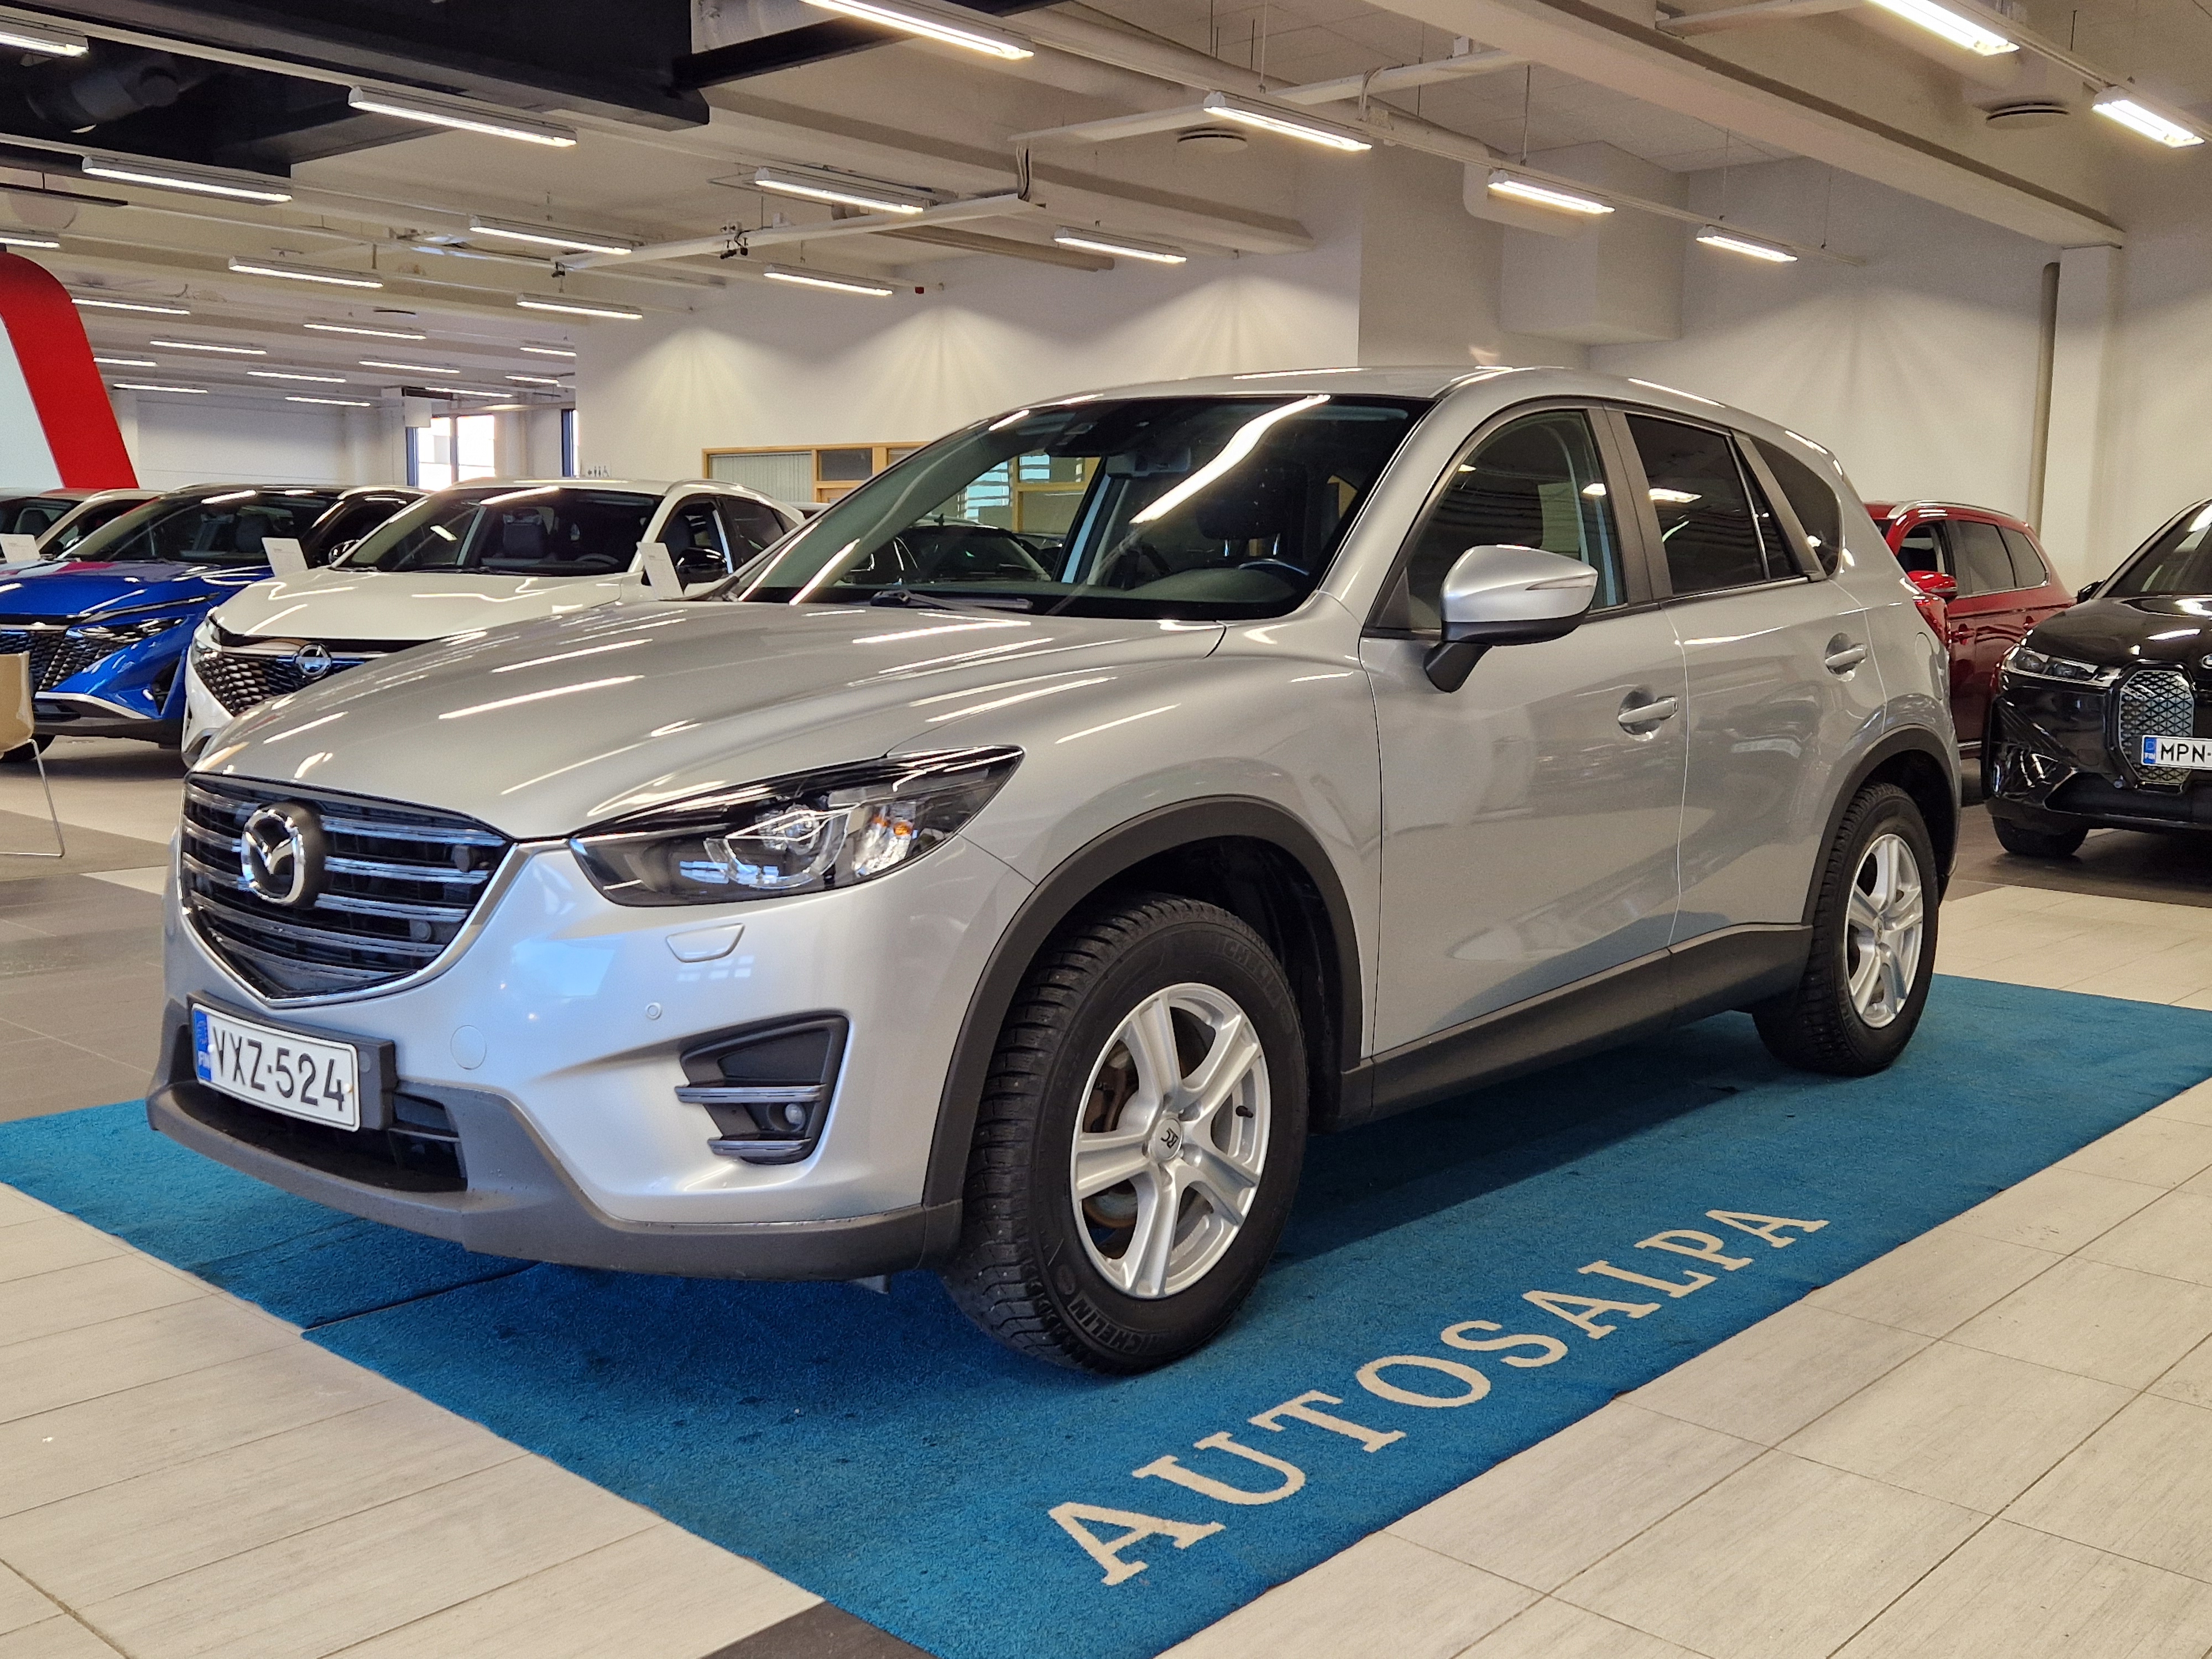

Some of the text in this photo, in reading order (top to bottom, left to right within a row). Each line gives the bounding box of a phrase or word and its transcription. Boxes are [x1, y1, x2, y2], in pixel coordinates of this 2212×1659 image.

[212, 1026, 345, 1112] VXZ-524
[1161, 1128, 1178, 1148] RC
[1048, 1208, 1829, 1585] AUTOSALPA
